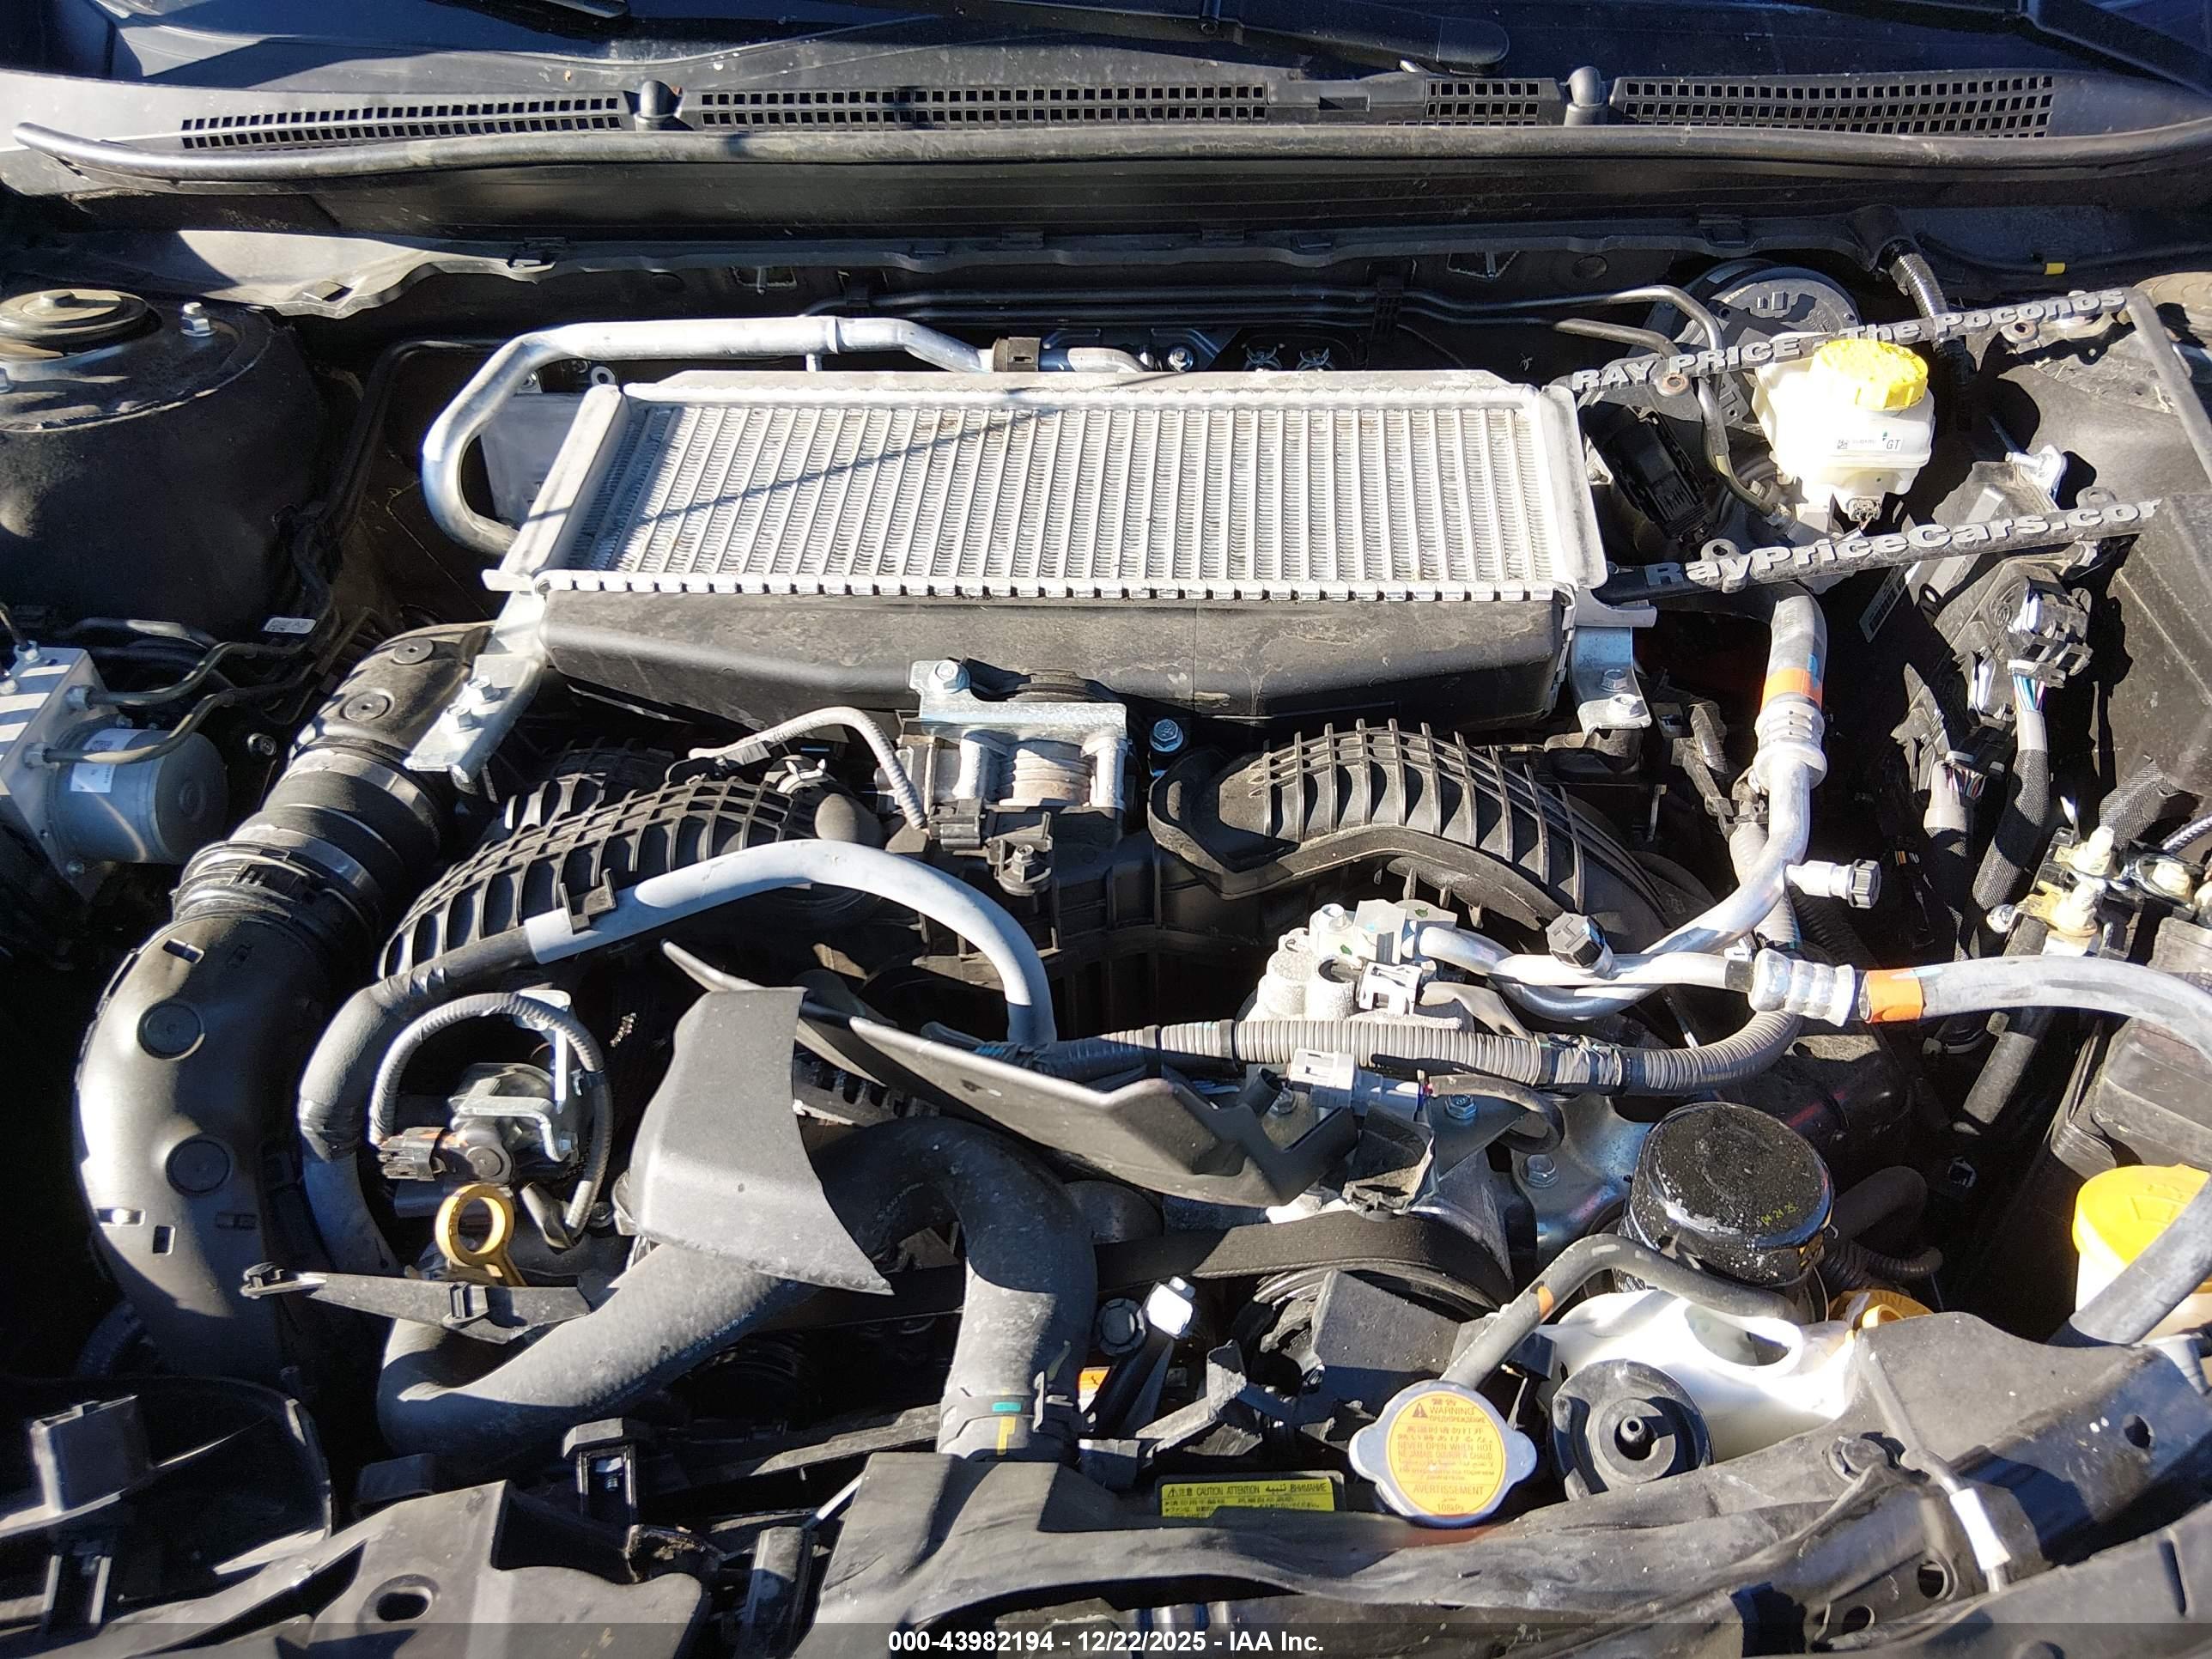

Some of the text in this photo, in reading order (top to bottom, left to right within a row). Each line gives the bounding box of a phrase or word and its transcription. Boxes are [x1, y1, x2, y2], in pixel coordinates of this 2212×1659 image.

[1572, 359, 1656, 391] RAY
[1668, 337, 1801, 374] PRICE
[1839, 321, 1923, 343] The
[1936, 289, 2127, 333] Poconos
[1886, 439, 1901, 450] GT
[1430, 1407, 1475, 1415] WARNING
[1398, 1442, 1492, 1452] NEVER OPEN WHEN HOT
[1196, 1486, 1224, 1496] CAUTION
[1226, 1485, 1261, 1495] ATTENTION
[1413, 1484, 1485, 1495] AVERTISSEMENT
